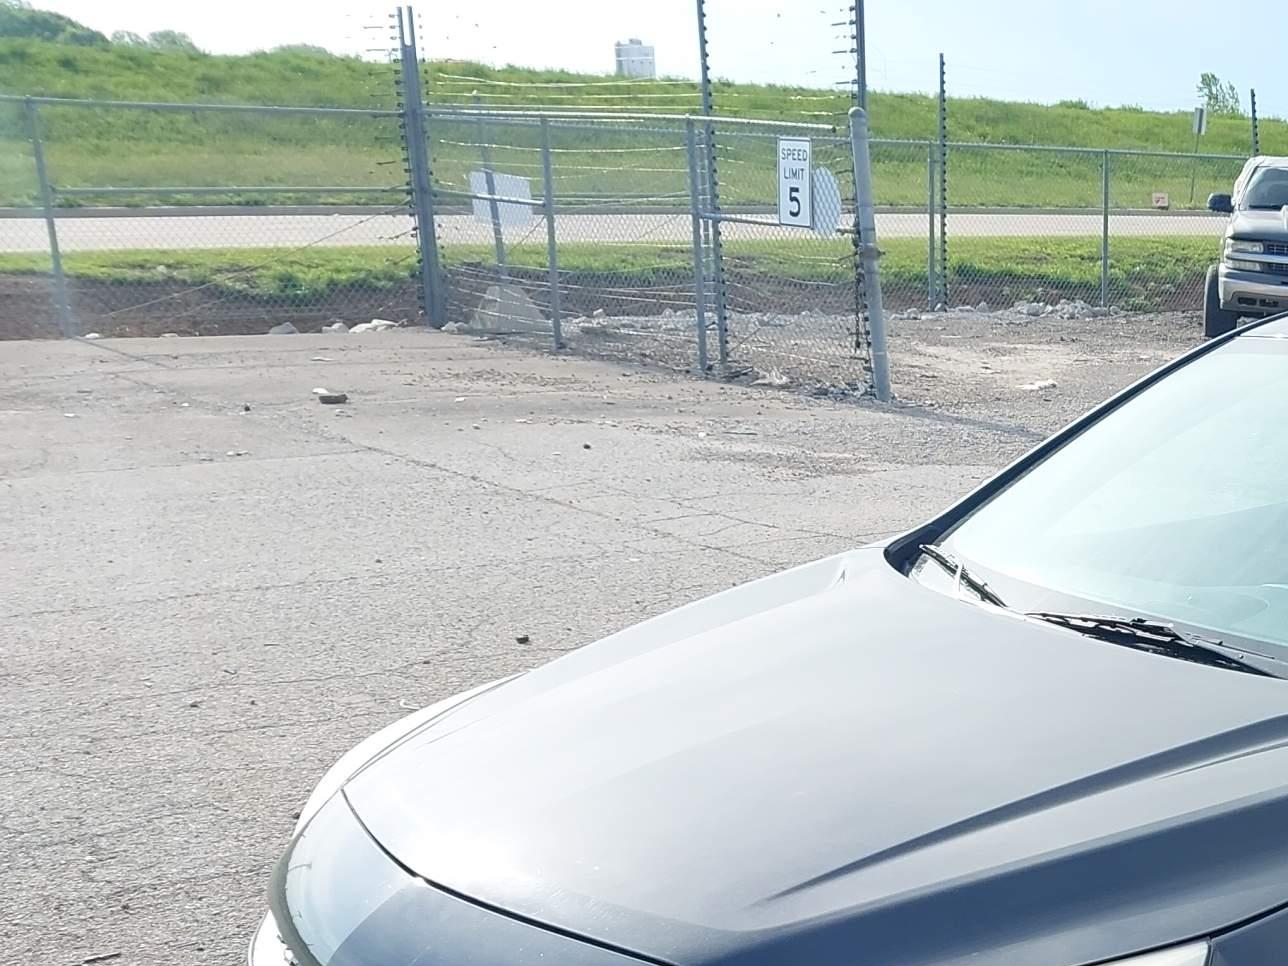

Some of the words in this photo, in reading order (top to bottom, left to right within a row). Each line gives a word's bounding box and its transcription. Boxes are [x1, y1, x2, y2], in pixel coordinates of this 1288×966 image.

[781, 148, 808, 161] SPEED
[783, 168, 805, 180] LIMIT
[789, 186, 801, 217] 5
